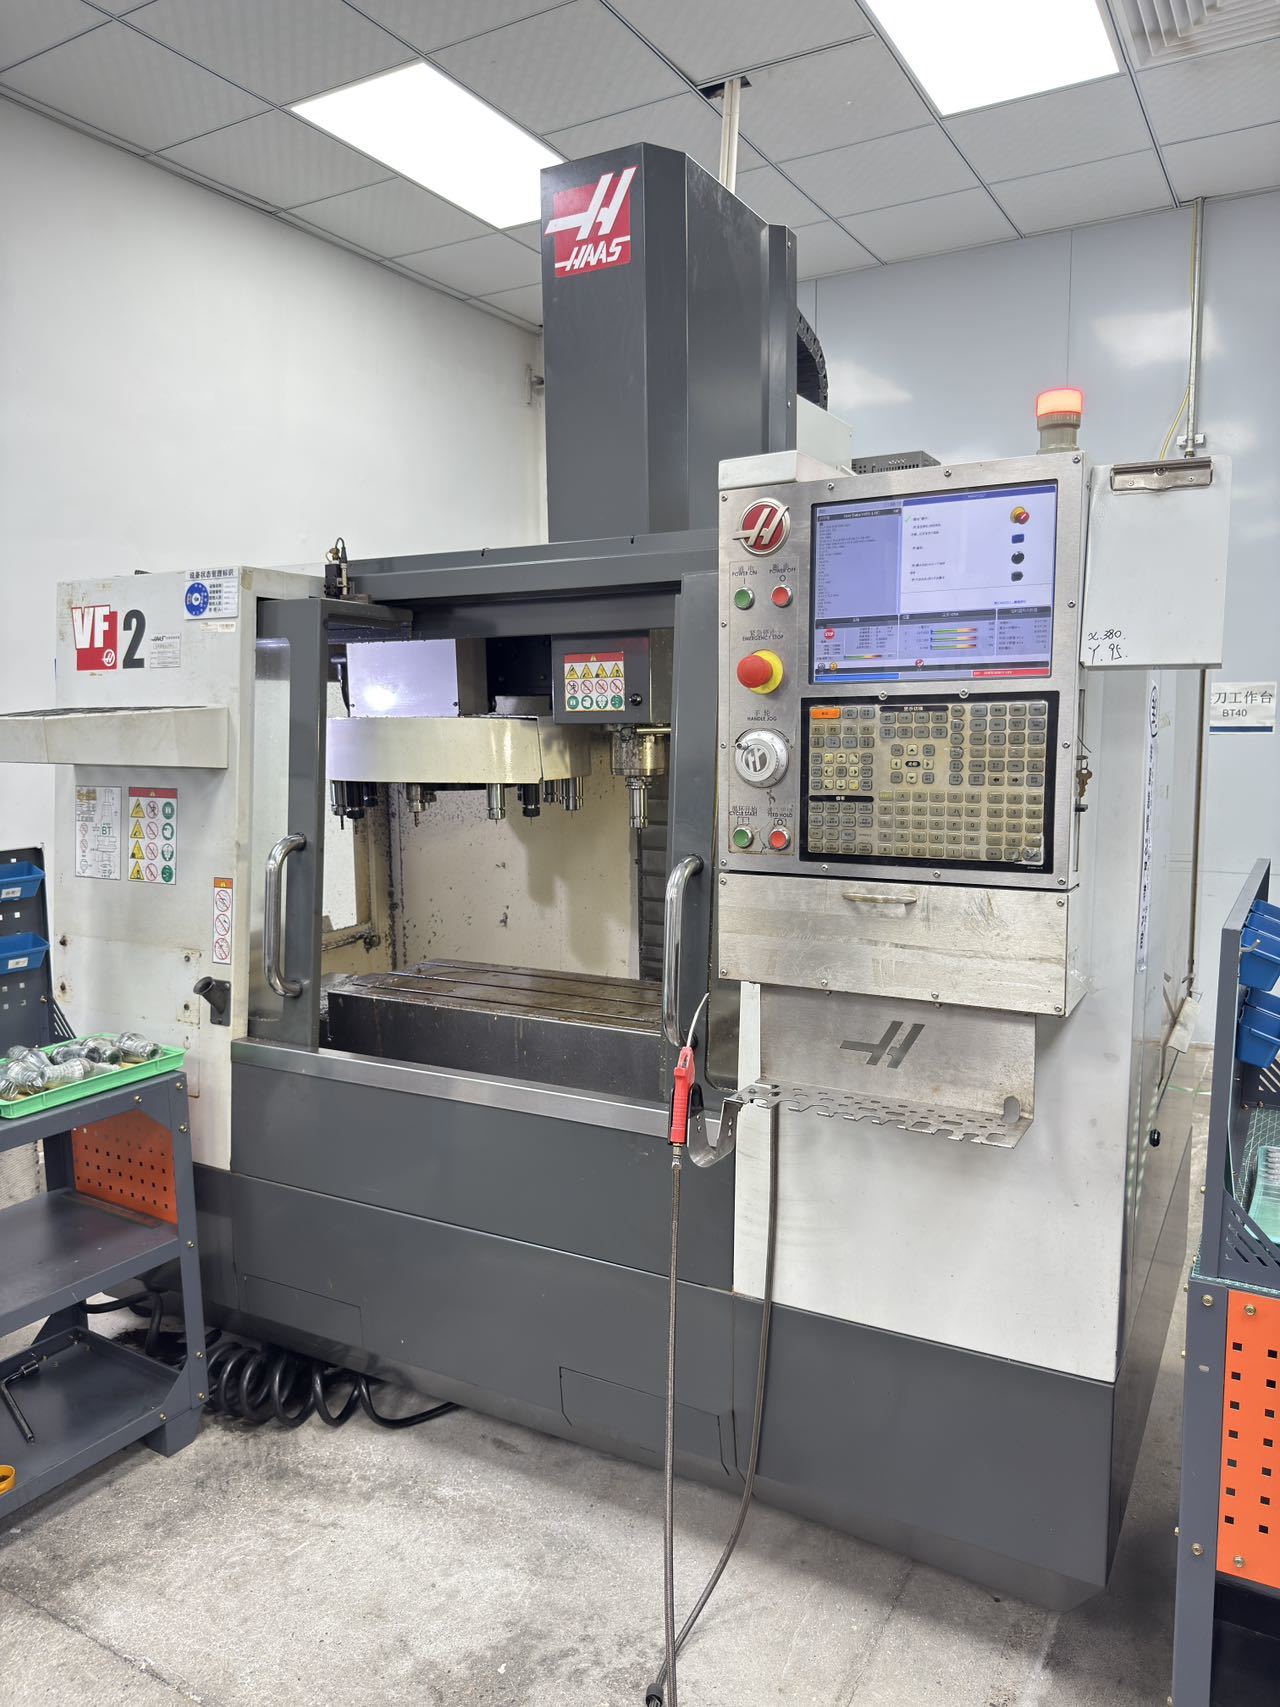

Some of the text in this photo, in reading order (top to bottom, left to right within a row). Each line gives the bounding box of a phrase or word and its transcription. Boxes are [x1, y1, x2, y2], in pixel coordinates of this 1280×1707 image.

[555, 235, 630, 271] HAAS
[71, 606, 111, 650] VF
[123, 609, 146, 669] 2
[1209, 690, 1273, 704] 刀工作台
[1222, 709, 1248, 717] BT40
[101, 826, 112, 835] BT
